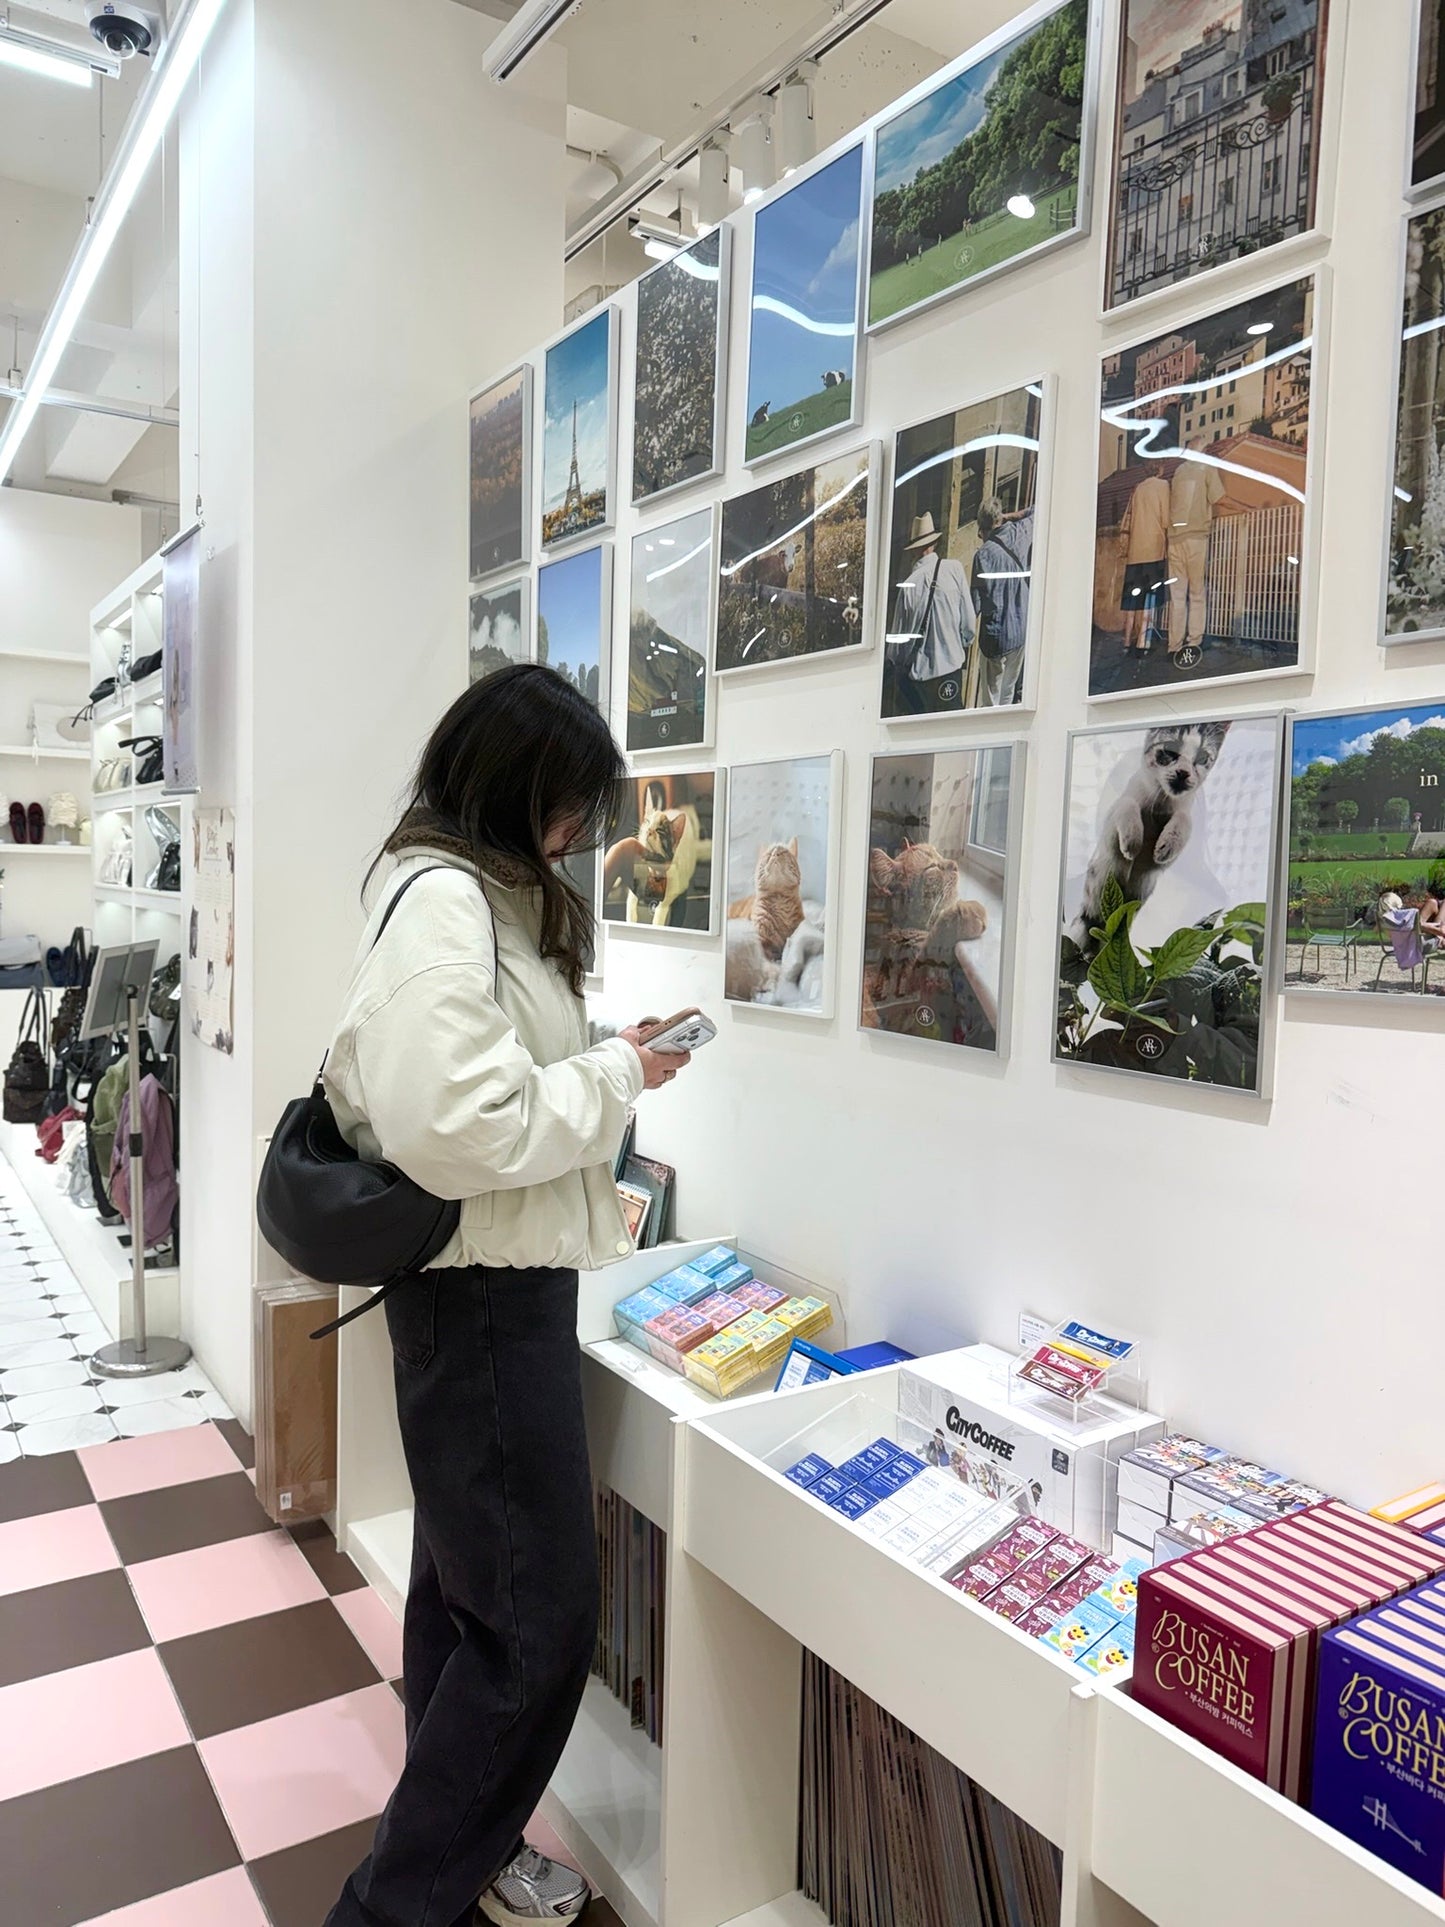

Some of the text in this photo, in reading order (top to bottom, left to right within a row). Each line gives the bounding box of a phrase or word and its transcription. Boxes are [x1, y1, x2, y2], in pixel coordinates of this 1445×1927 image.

[1420, 768, 1439, 787] in
[1152, 1610, 1250, 1687] BUSAN
[1155, 1651, 1255, 1725] COFFEE
